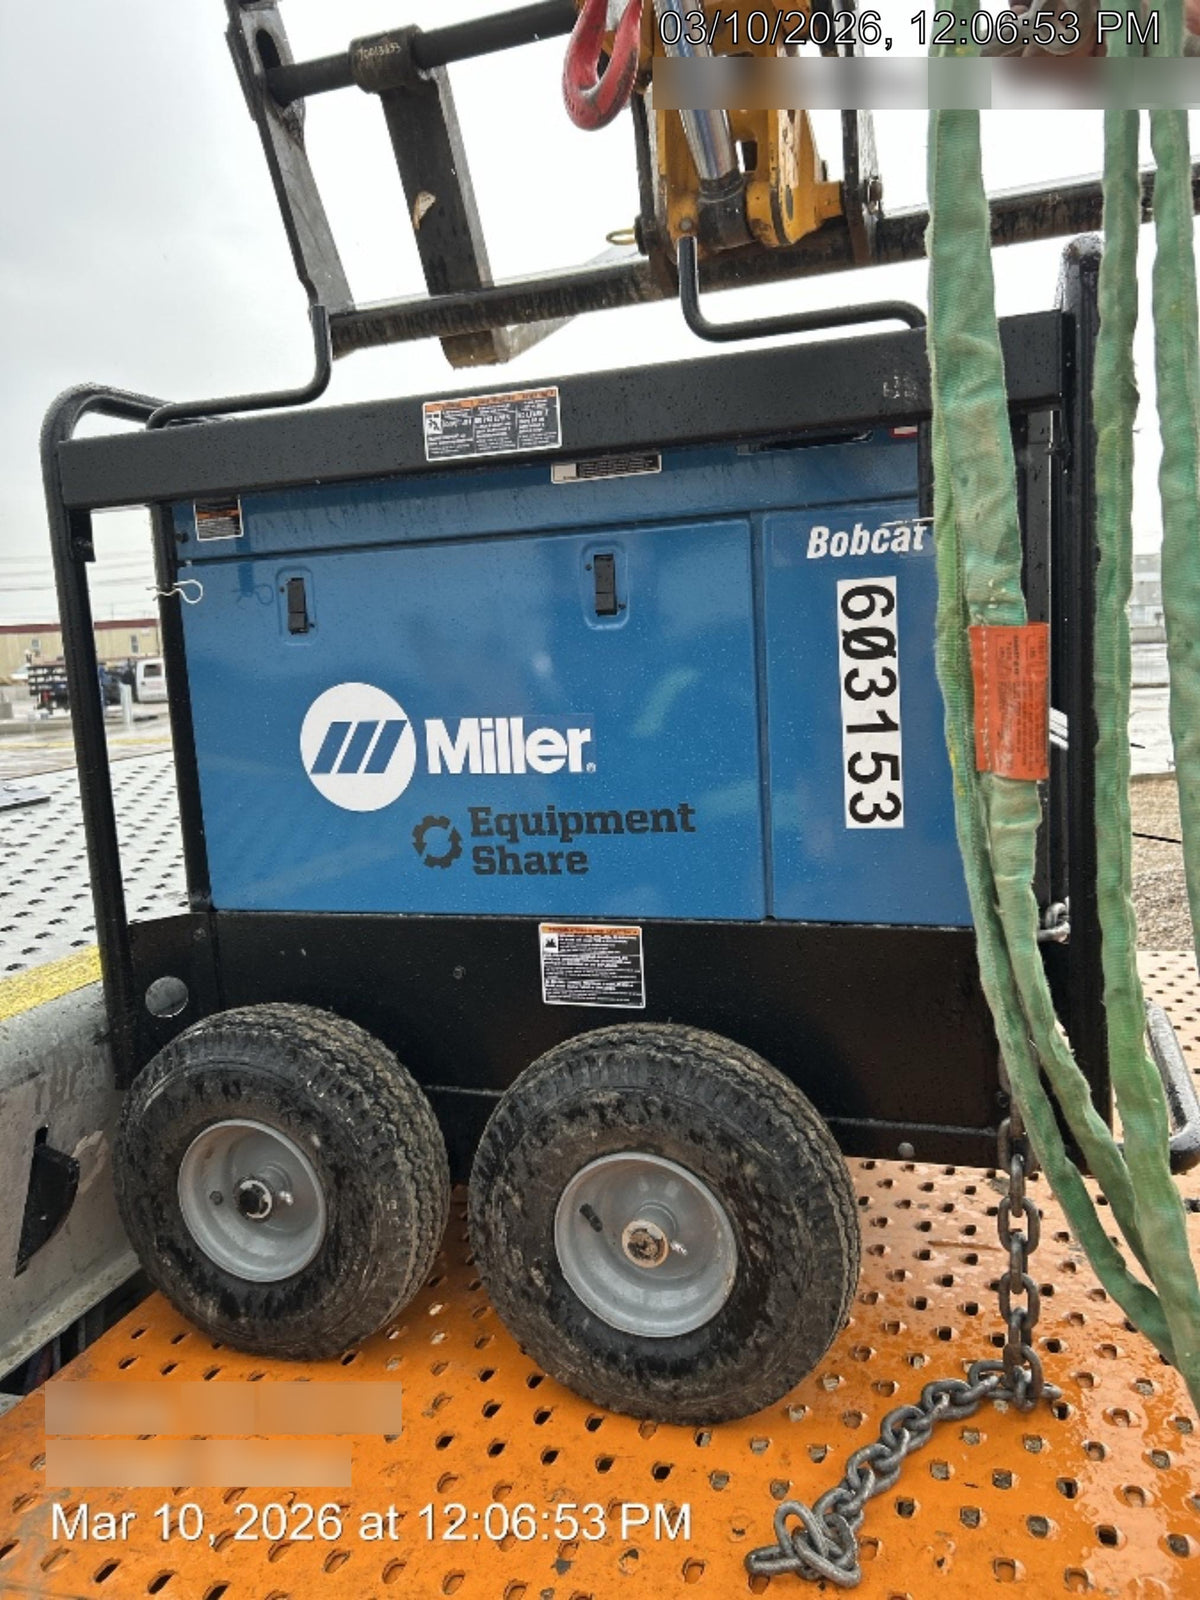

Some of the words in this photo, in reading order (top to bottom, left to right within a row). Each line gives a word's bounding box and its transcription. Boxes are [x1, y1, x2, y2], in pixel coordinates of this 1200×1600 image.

[806, 522, 927, 559] Bobcat
[840, 585, 902, 824] 603153
[468, 803, 697, 843] Equipment
[472, 845, 589, 876] Share
